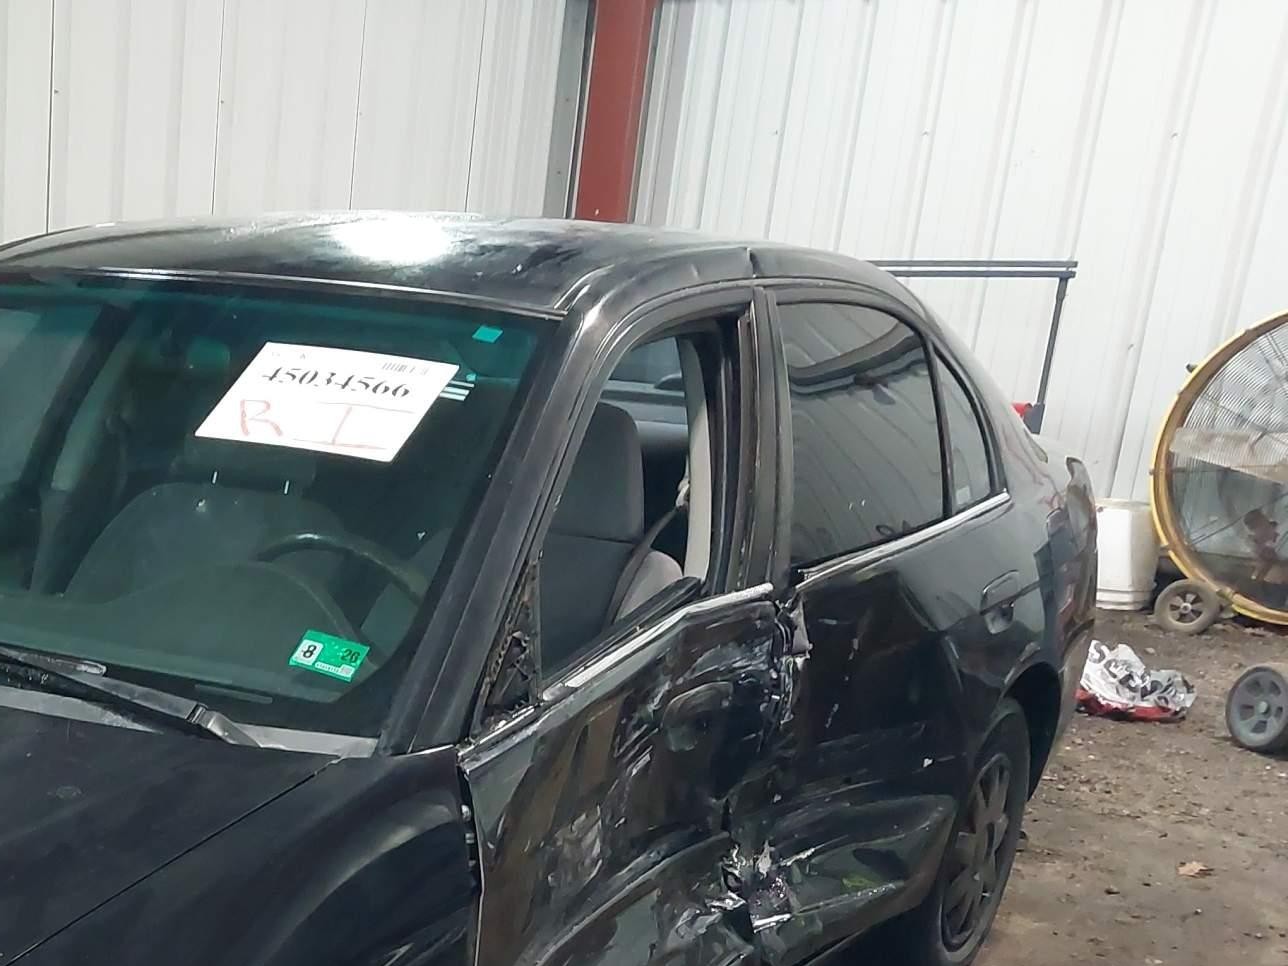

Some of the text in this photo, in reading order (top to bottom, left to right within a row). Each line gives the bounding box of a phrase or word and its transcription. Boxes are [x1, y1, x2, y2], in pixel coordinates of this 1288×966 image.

[263, 367, 410, 397] 45034566
[239, 398, 284, 437] R
[303, 645, 317, 658] 8
